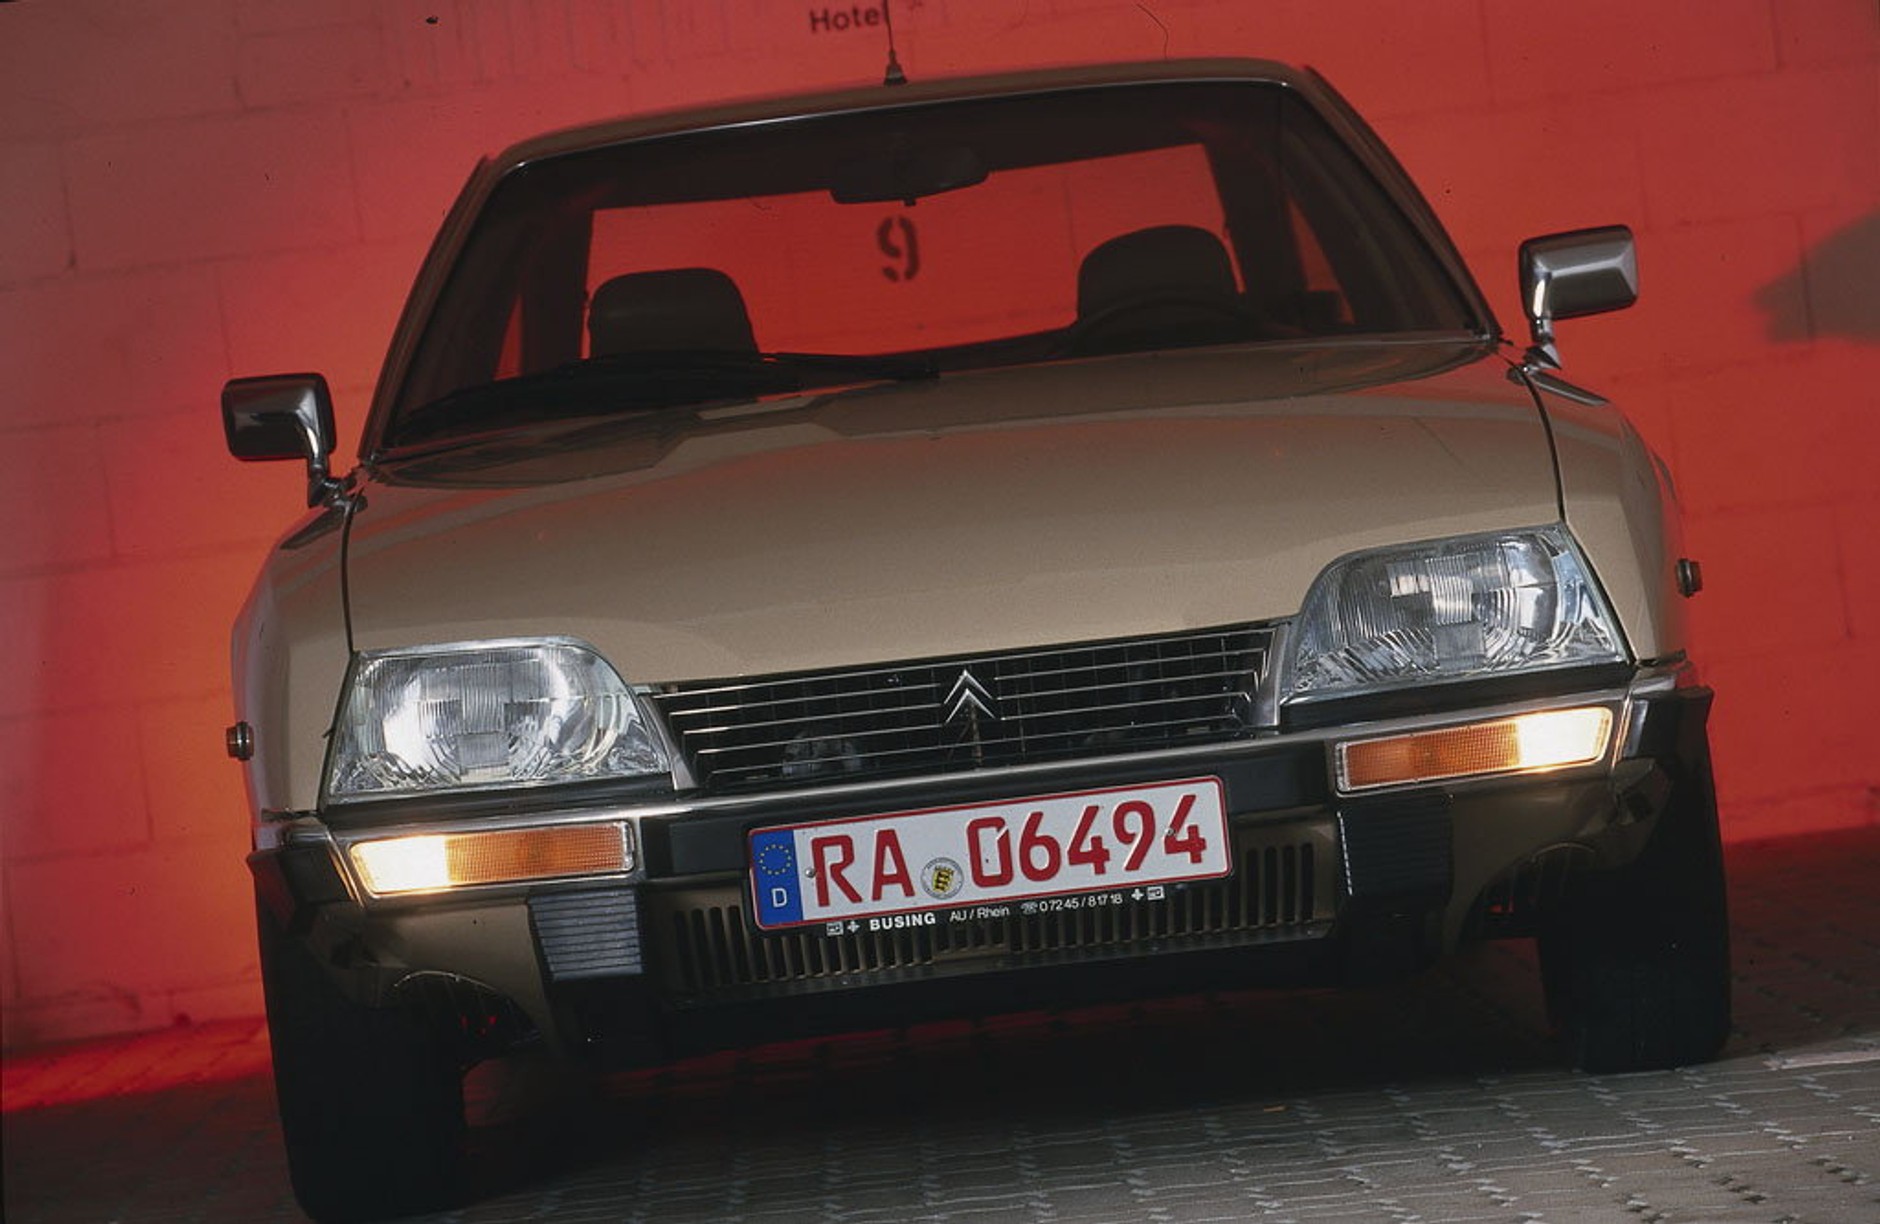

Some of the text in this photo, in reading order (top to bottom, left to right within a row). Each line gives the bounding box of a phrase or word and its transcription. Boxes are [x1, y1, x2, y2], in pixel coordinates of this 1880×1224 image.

[876, 216, 920, 282] 9
[811, 828, 915, 907] RA
[966, 794, 1207, 888] 06494
[771, 887, 788, 908] D
